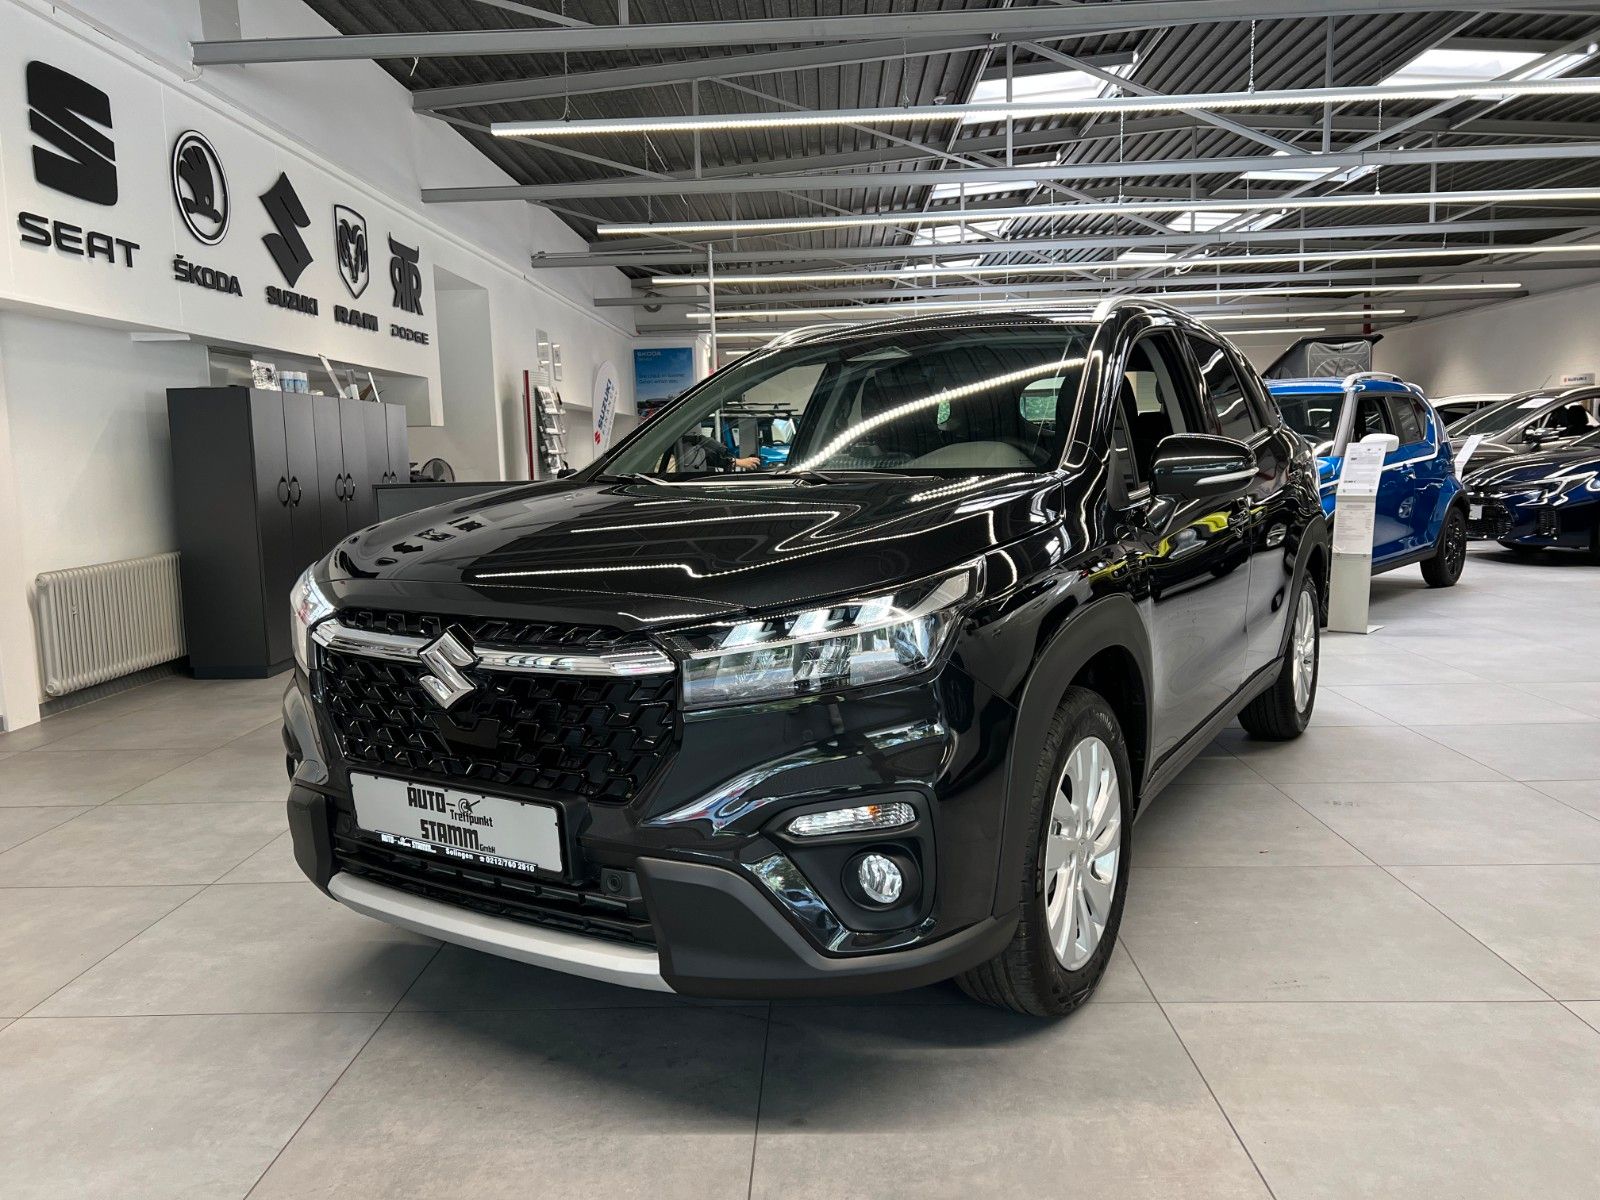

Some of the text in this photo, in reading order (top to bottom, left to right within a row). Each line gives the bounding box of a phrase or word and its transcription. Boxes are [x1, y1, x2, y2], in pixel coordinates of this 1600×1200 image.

[18, 211, 140, 268] SEAT
[173, 254, 243, 297] ŠKODA
[266, 286, 319, 316] SUZUKI
[334, 304, 379, 331] RAM
[390, 324, 429, 345] DODGE
[598, 378, 611, 429] SUZUKI
[451, 810, 493, 827] Treffpunkt
[420, 819, 479, 850] STAMM
[479, 844, 495, 853] GmbH
[445, 847, 473, 860] Solingen
